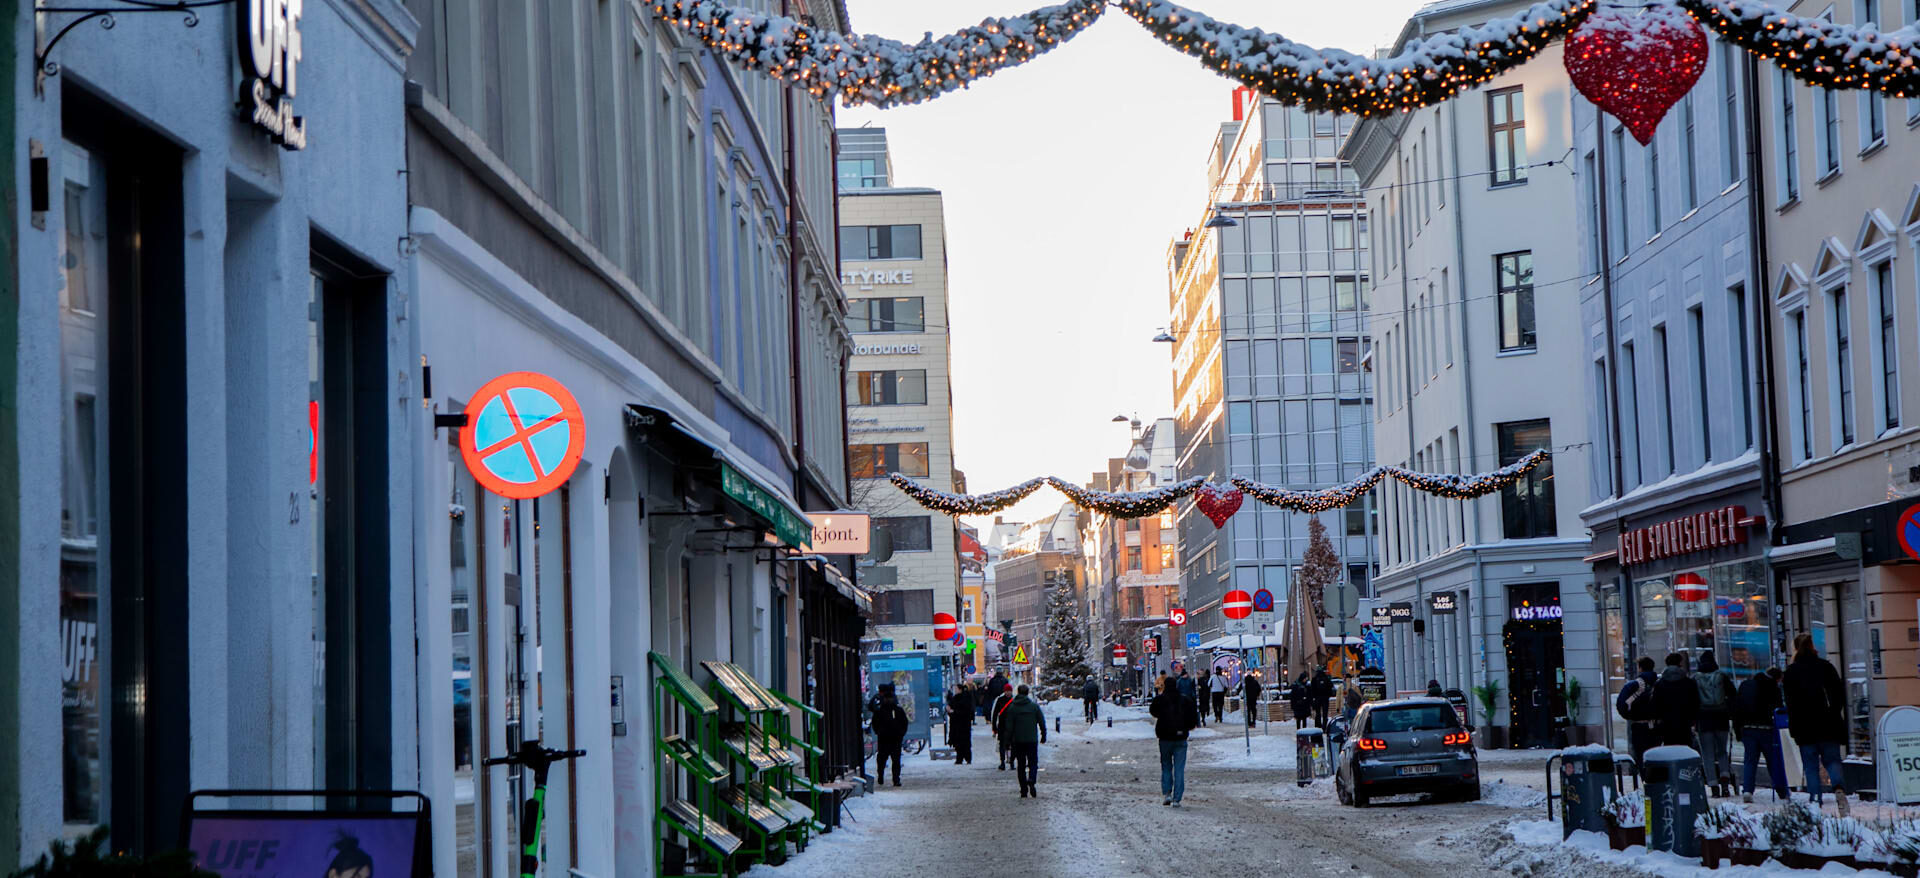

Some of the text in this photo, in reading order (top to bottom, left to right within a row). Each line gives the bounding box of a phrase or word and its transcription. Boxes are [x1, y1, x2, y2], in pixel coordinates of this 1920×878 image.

[250, 0, 302, 98] UFF
[1618, 506, 1737, 566] OSLO SPORTSLAGER
[1514, 607, 1534, 619] LOS
[62, 619, 96, 682] UFF
[206, 840, 280, 869] UFF
